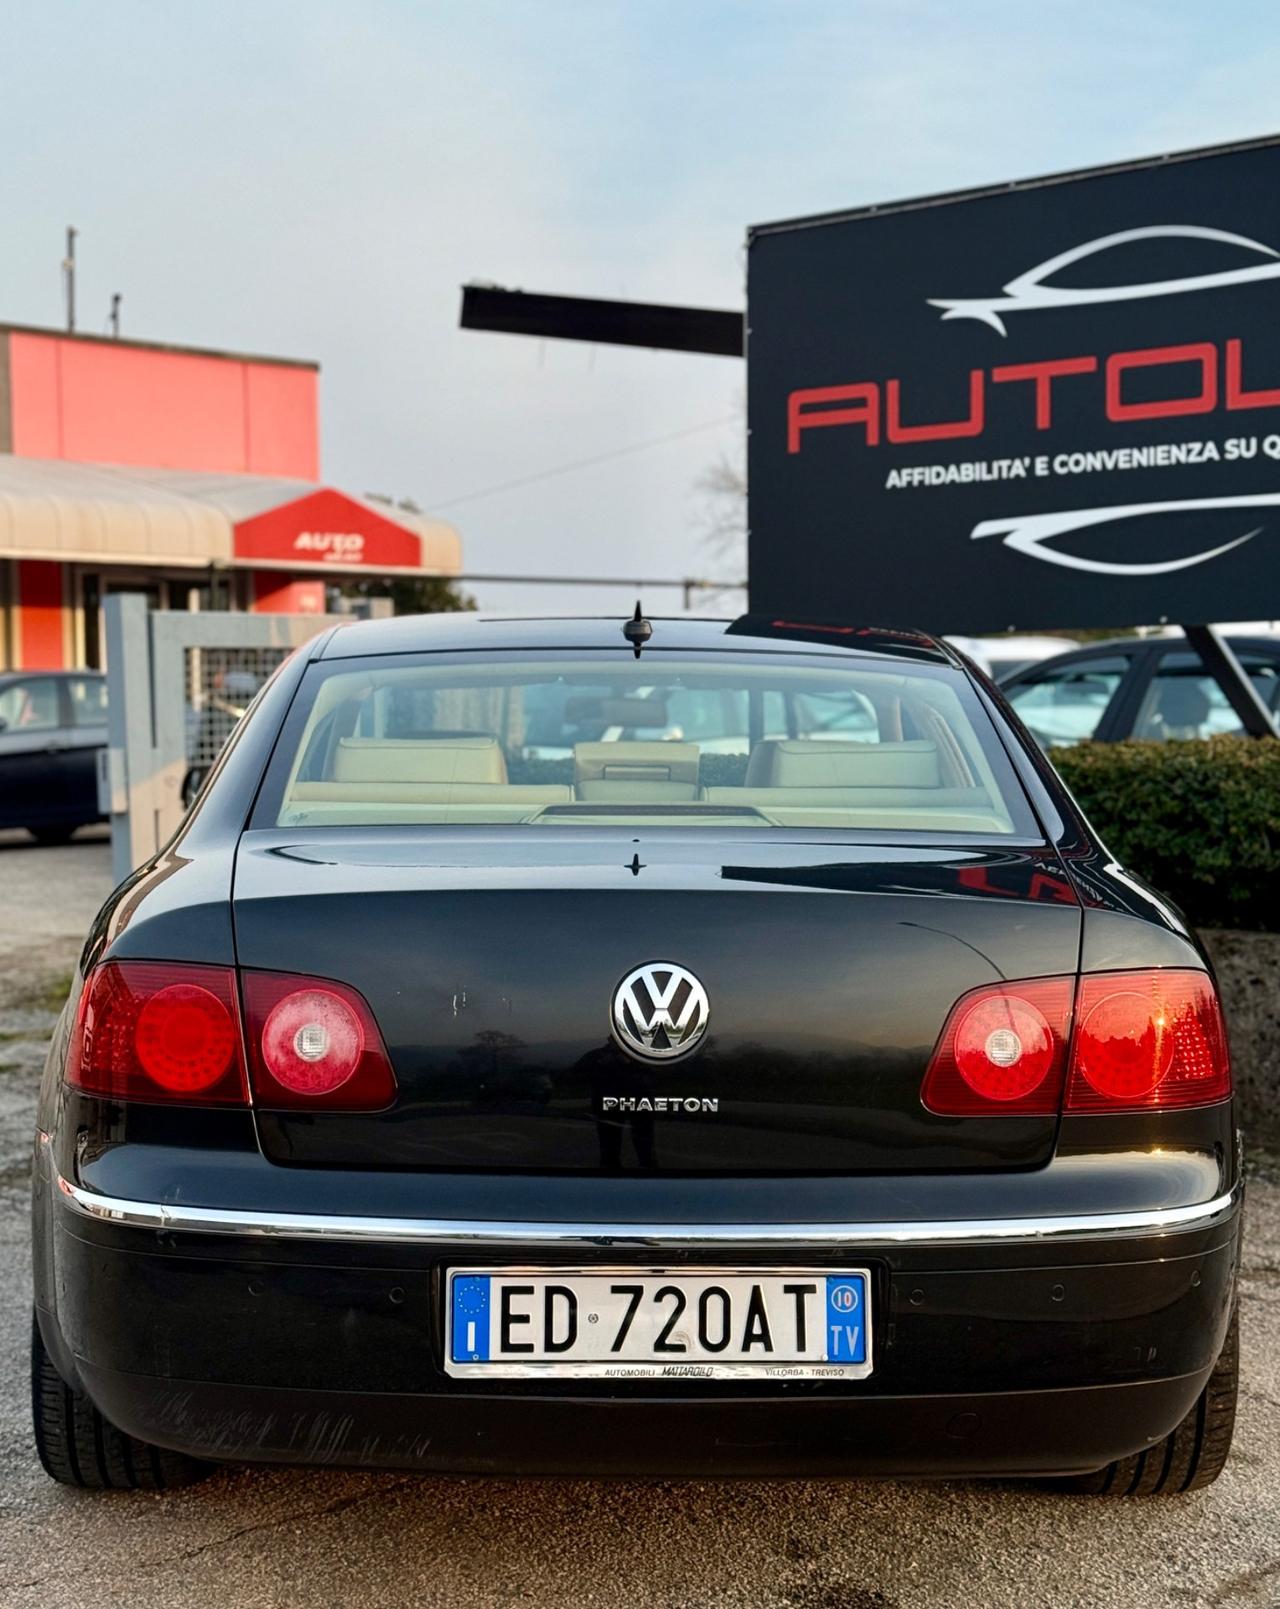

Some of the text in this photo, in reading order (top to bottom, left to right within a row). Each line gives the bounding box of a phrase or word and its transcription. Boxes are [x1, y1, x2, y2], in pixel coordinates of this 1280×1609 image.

[885, 456, 1031, 489] AFFIDABILITA'
[1034, 455, 1050, 477] E
[1053, 438, 1220, 475] CONVENIENZA
[1224, 436, 1258, 460] SU
[294, 531, 365, 552] AUTO
[602, 1097, 719, 1112] PHAETON
[838, 1291, 852, 1307] 10
[500, 1284, 817, 1353] ED 720AT
[831, 1325, 860, 1356] TV
[604, 1368, 656, 1377] AUTOMOBILI
[811, 1368, 845, 1377] TREVISO
